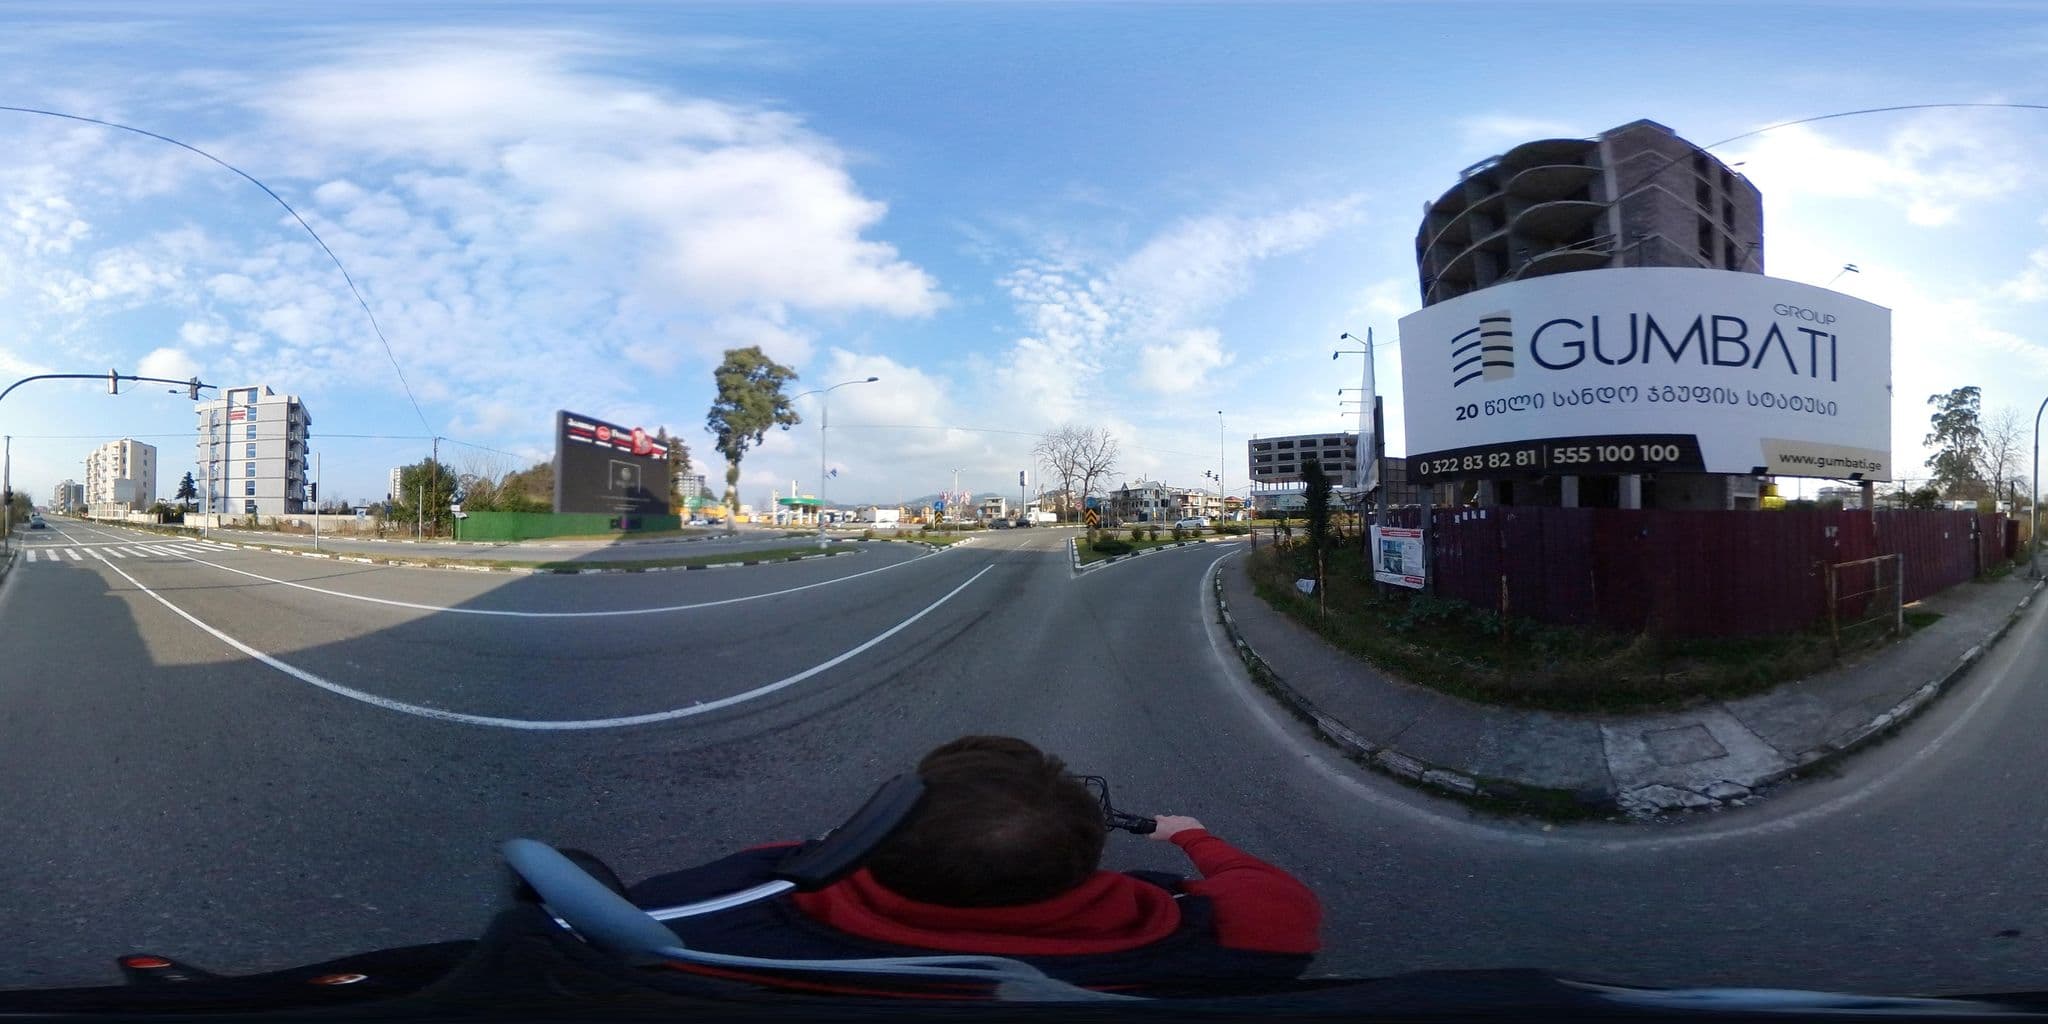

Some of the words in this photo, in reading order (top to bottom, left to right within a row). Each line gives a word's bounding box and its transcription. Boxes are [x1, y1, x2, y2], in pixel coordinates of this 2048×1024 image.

[1773, 303, 1836, 325] GROUP
[1530, 313, 1836, 381] GUMBATI
[1456, 404, 1478, 421] 20
[1485, 393, 1544, 415] წელი
[1553, 386, 1638, 407] სანდო
[1648, 386, 1739, 404] ჯგუფის
[1747, 390, 1837, 416] სტატუსი
[1420, 462, 1428, 474] 0
[1433, 458, 1458, 473] 322
[1463, 455, 1483, 470] 83
[1489, 453, 1510, 467] 82
[1516, 450, 1535, 465] 81
[1554, 447, 1590, 463] 555
[1597, 446, 1634, 461] 100
[1641, 445, 1679, 461] 100
[1779, 453, 1882, 473] www.gumbati.ge
